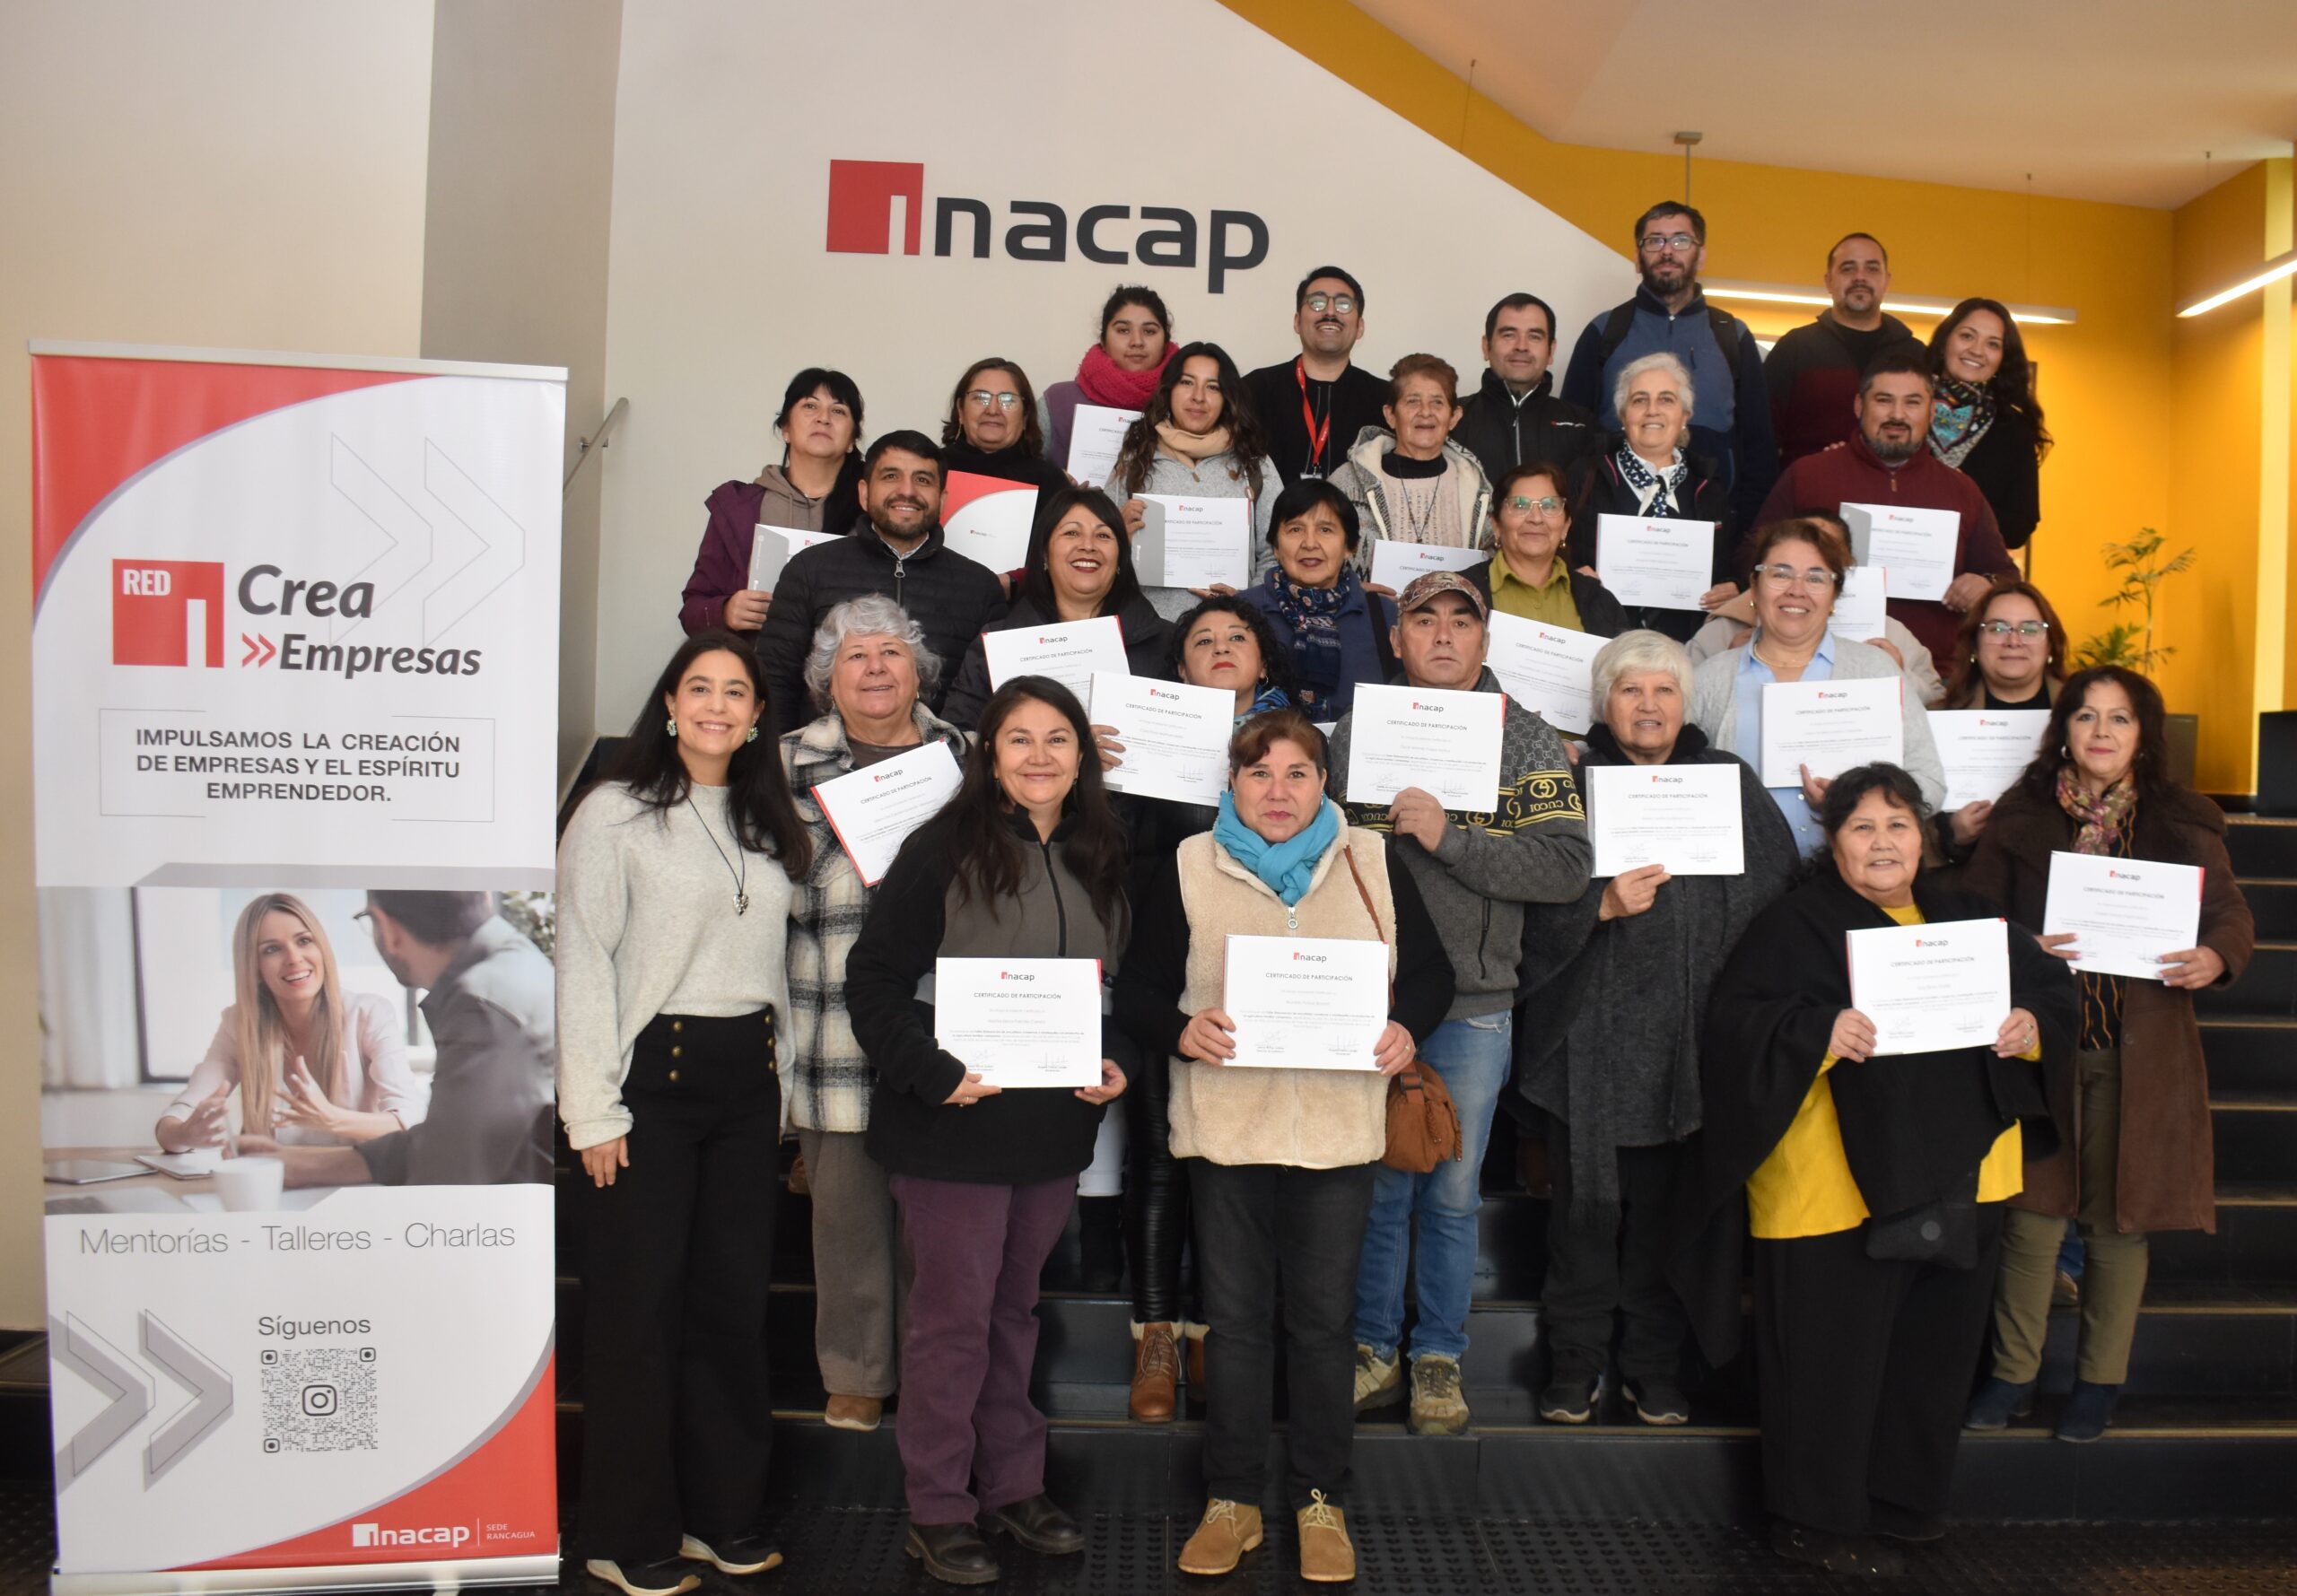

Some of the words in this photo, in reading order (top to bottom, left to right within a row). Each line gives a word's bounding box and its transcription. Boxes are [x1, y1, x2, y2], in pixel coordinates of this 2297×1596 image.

[123, 568, 170, 597] RED
[238, 564, 374, 618] Crea
[280, 632, 482, 680] Empresas
[1125, 702, 1157, 713] CERTIFICADO
[1165, 709, 1202, 720] PARTICIPACIÓN
[1385, 718, 1420, 728] CERTIFICADO
[1428, 722, 1467, 731] PARTICIPACIÓN
[136, 728, 291, 749] IMPULSAMOS
[303, 733, 330, 749] LA
[341, 730, 459, 753] CREACIÓN
[137, 755, 168, 772] DE
[174, 755, 299, 774] EMPRESAS
[304, 758, 318, 774] Y
[325, 759, 352, 775] EL
[358, 756, 459, 779] ESPÍRITU
[207, 781, 391, 802] EMPRENDEDOR.
[860, 789, 891, 805] CERTIFICADO
[1265, 972, 1302, 980] CERTIFICADO
[1311, 973, 1353, 982] PARTICIPACIÓN
[80, 1227, 229, 1255] Mentorías
[260, 1225, 371, 1251] Talleres
[405, 1222, 516, 1248] Charlas
[258, 1313, 371, 1340] Síguenos
[486, 1523, 508, 1531] SEDE
[486, 1531, 536, 1540] RANCAGUA
